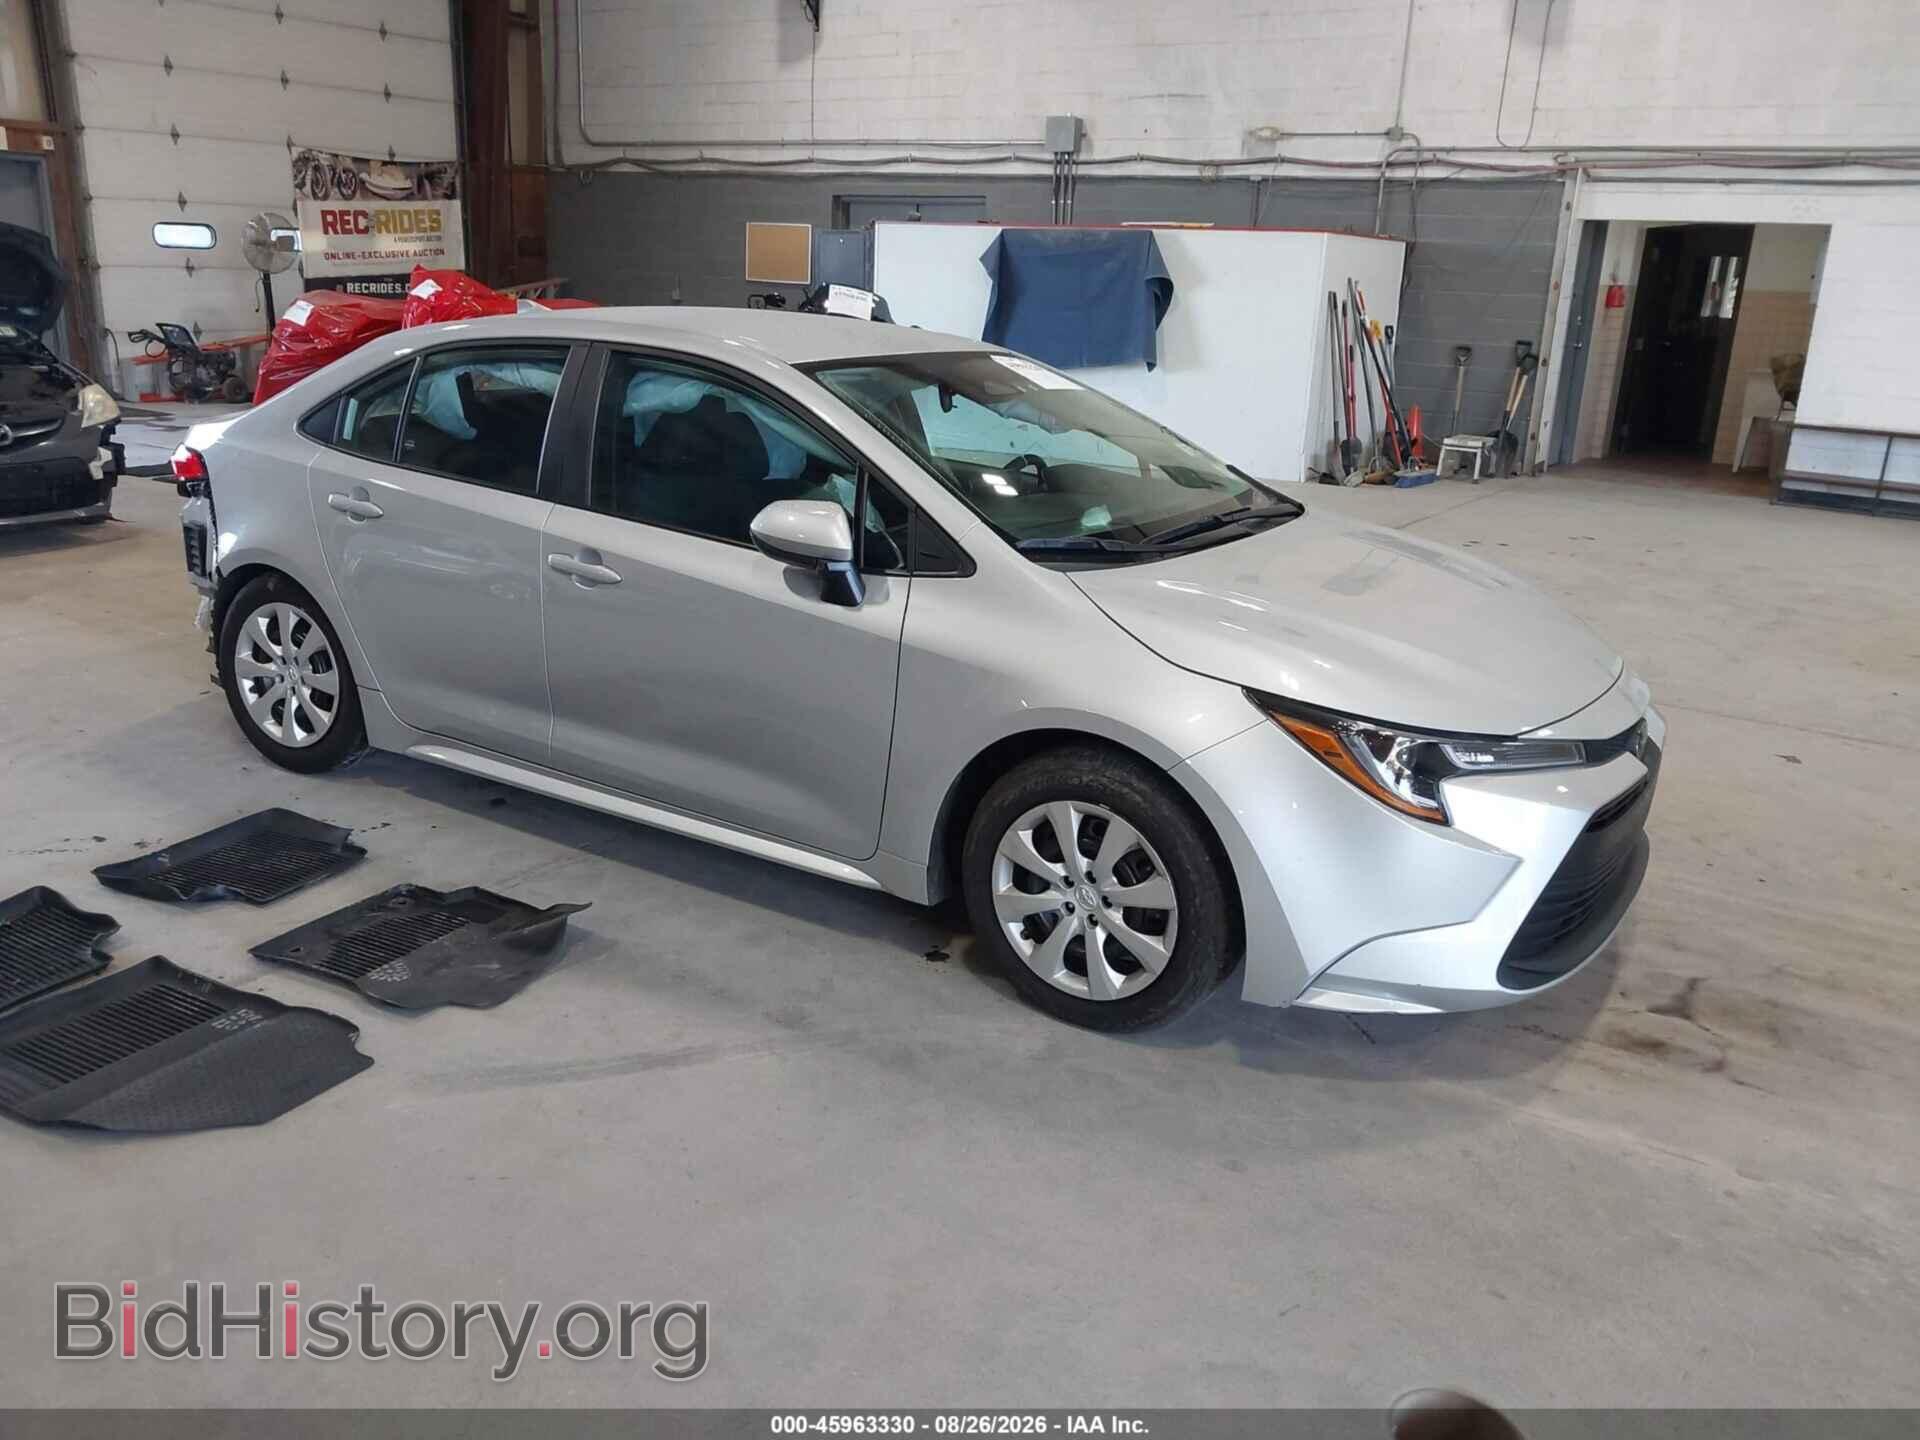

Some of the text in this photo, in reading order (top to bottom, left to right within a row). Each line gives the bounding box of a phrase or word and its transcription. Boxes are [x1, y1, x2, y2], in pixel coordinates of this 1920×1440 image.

[321, 209, 441, 235] REC RIDES
[324, 247, 445, 260] ONLINE-EXCLUSIVE AUCTION
